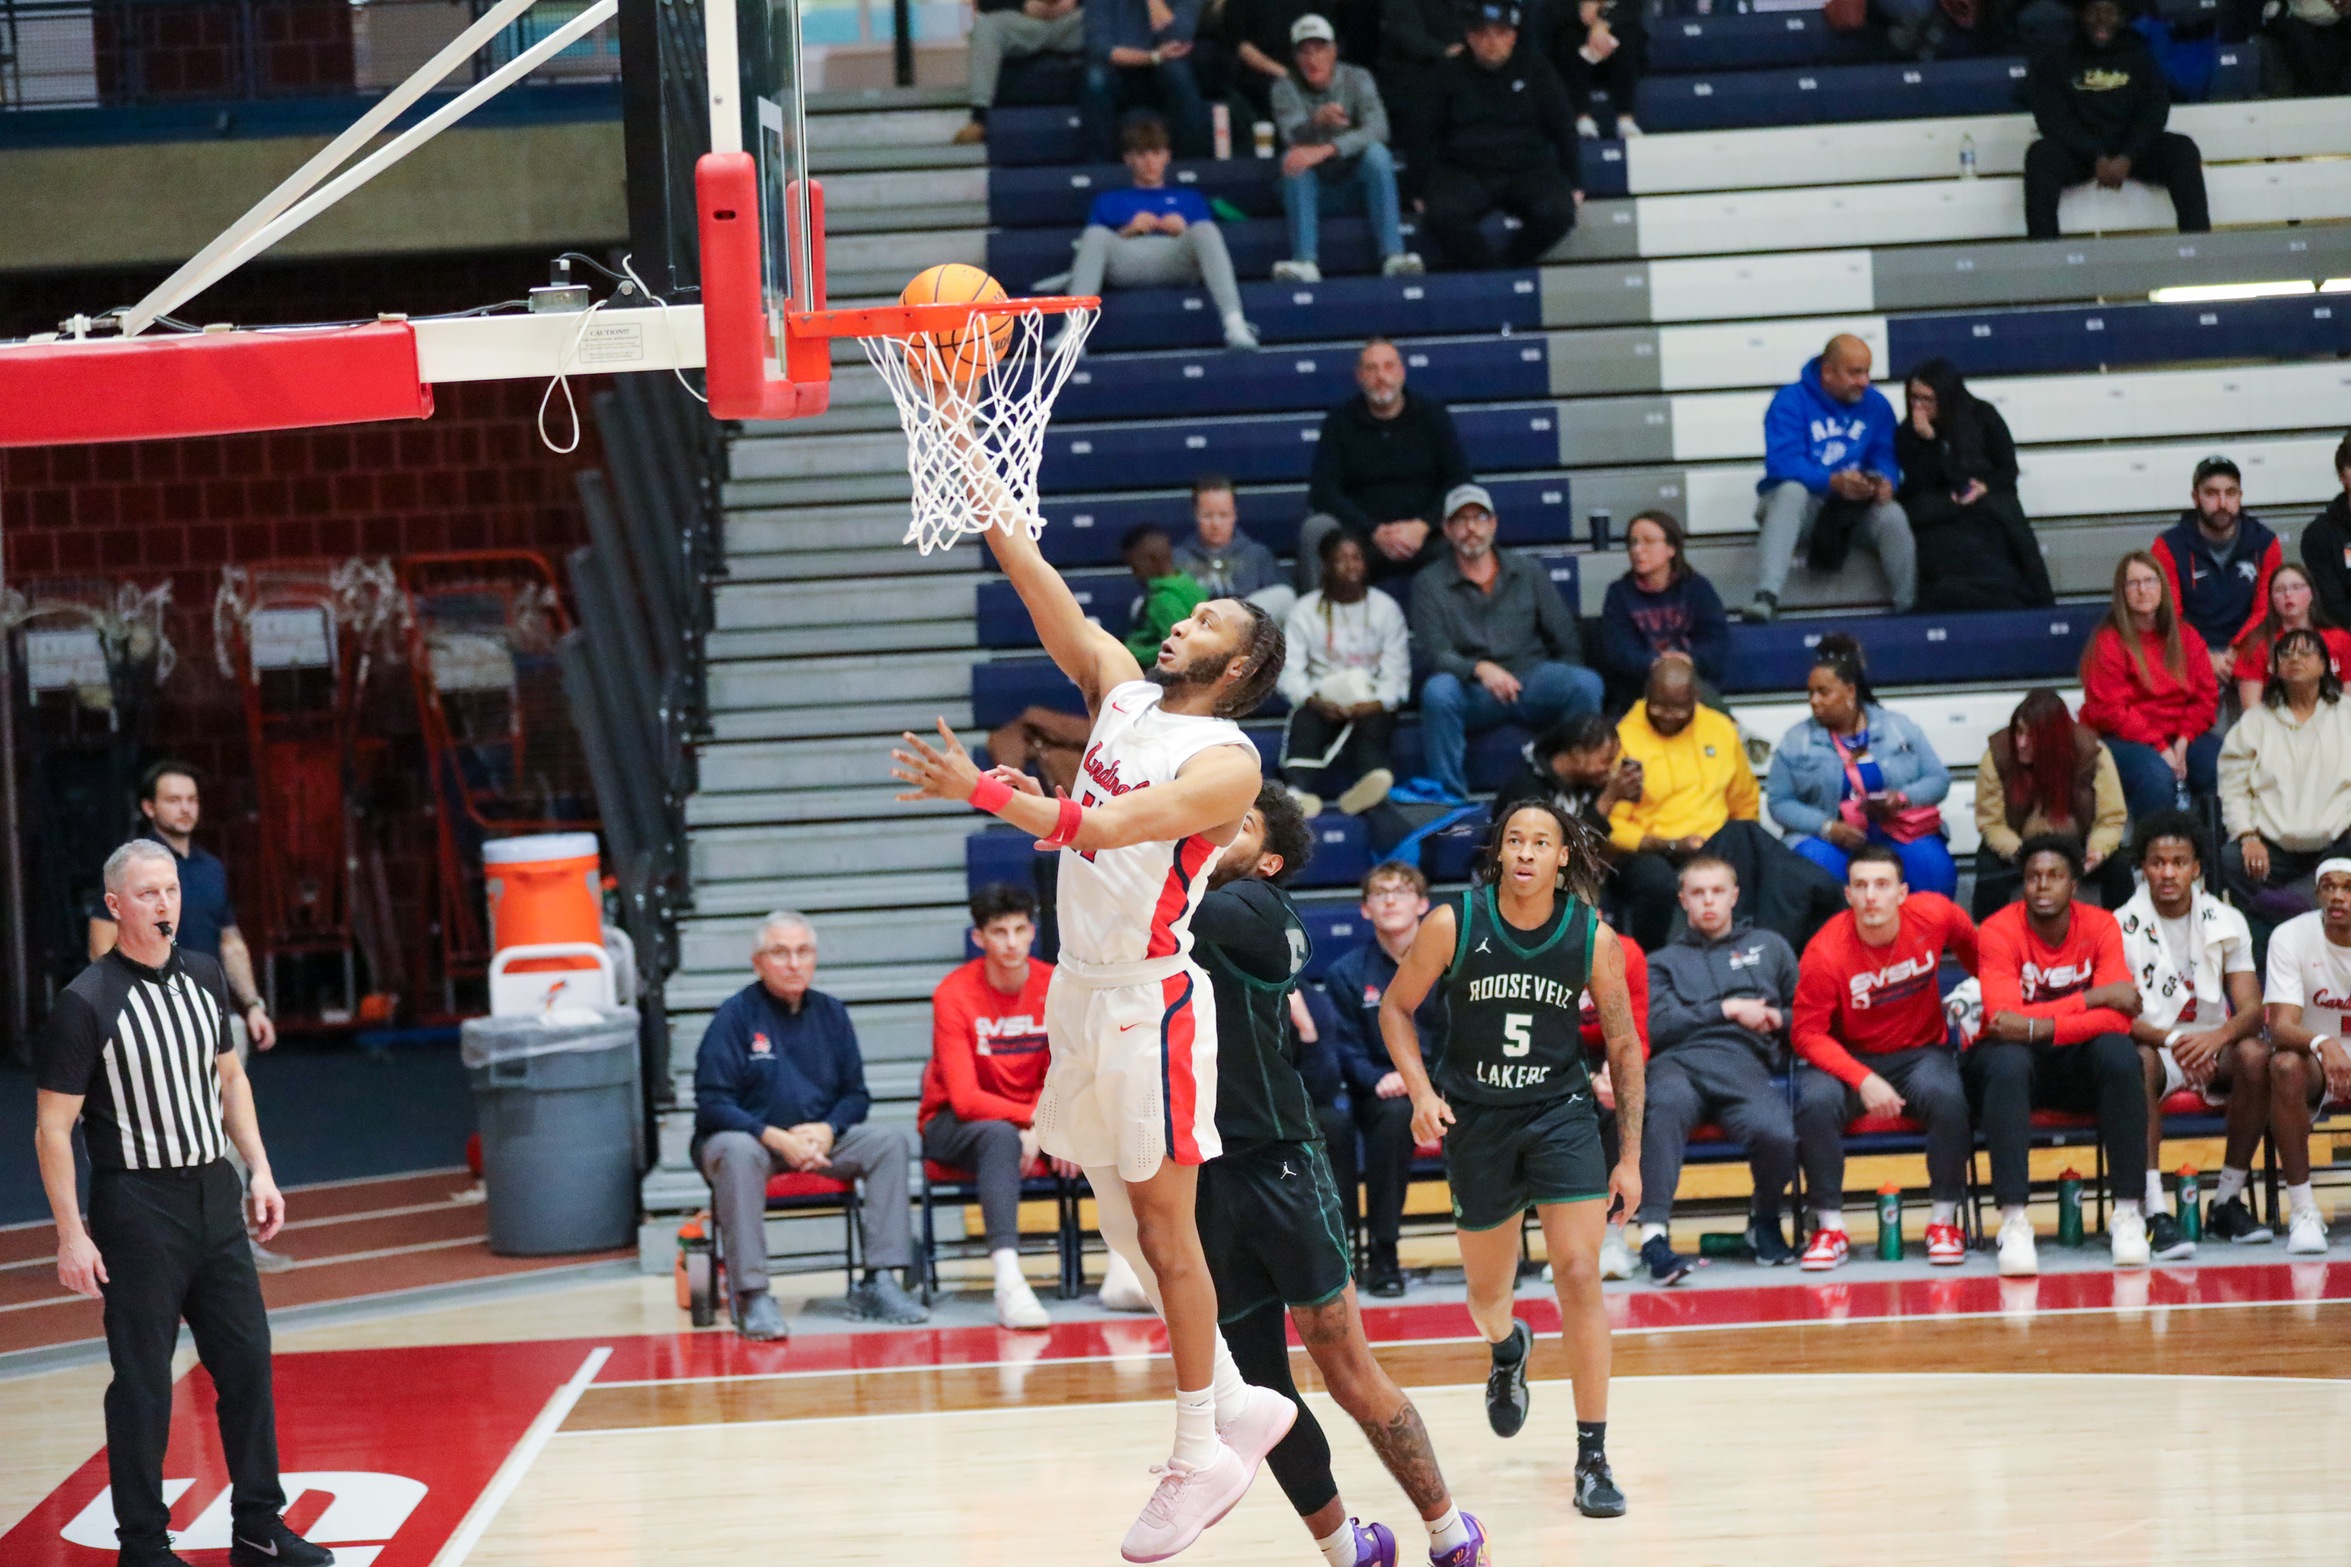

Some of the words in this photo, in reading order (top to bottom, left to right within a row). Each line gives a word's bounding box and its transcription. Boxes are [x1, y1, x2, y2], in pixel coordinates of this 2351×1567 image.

[1849, 949, 1935, 996] SVSU
[2021, 957, 2092, 988] SVSU
[1469, 973, 1573, 1009] ROOSEVELT
[1502, 1013, 1533, 1057] 5
[1476, 1061, 1551, 1089] LAKERS
